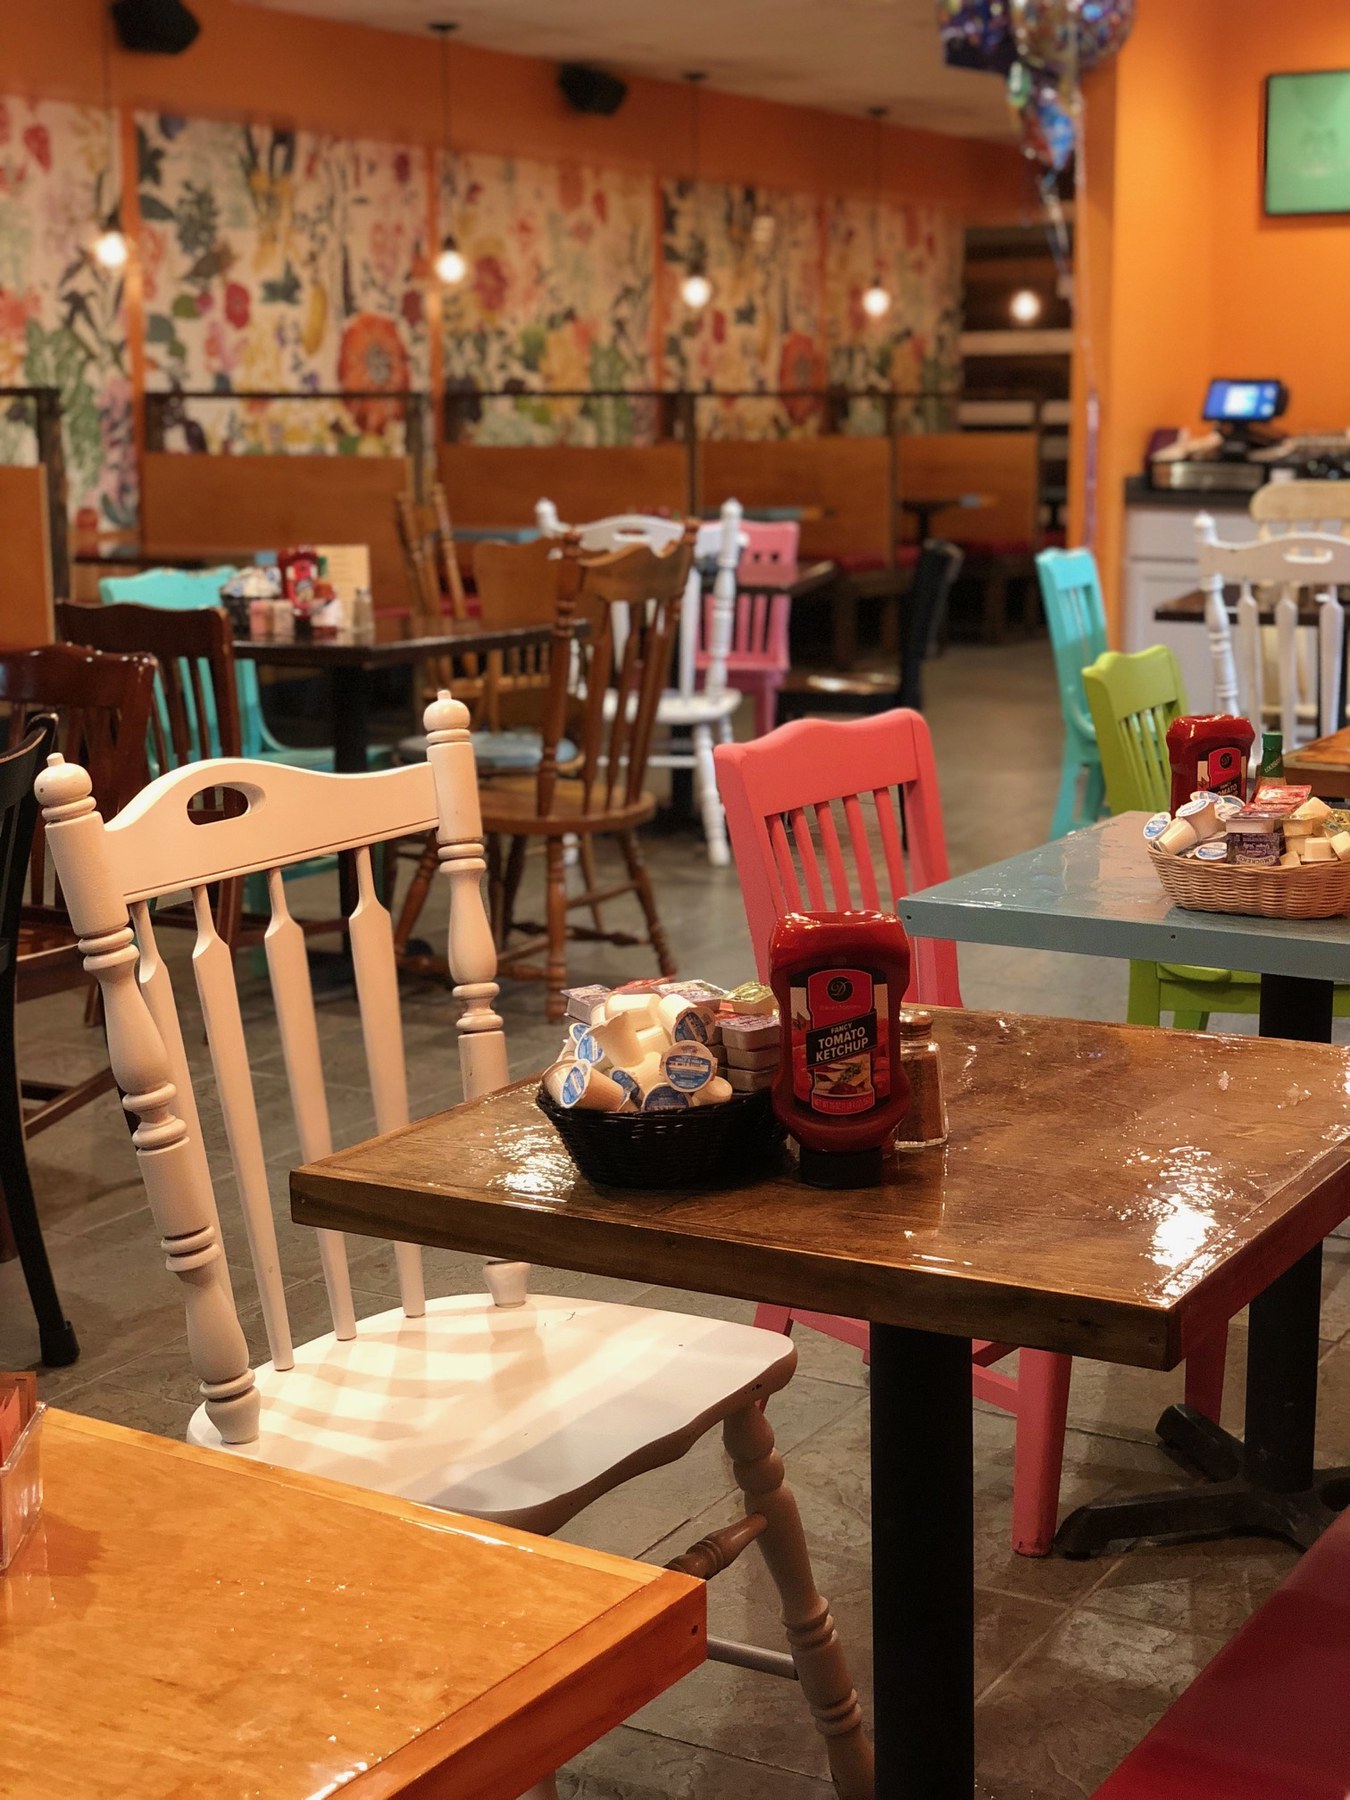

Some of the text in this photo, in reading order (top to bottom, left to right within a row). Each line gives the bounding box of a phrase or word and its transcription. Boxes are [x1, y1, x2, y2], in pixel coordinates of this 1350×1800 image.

[1216, 783, 1238, 796] OMATO
[830, 1022, 853, 1034] FANCY
[818, 1026, 866, 1050] TOMATO
[815, 1037, 869, 1062] KETCHUP
